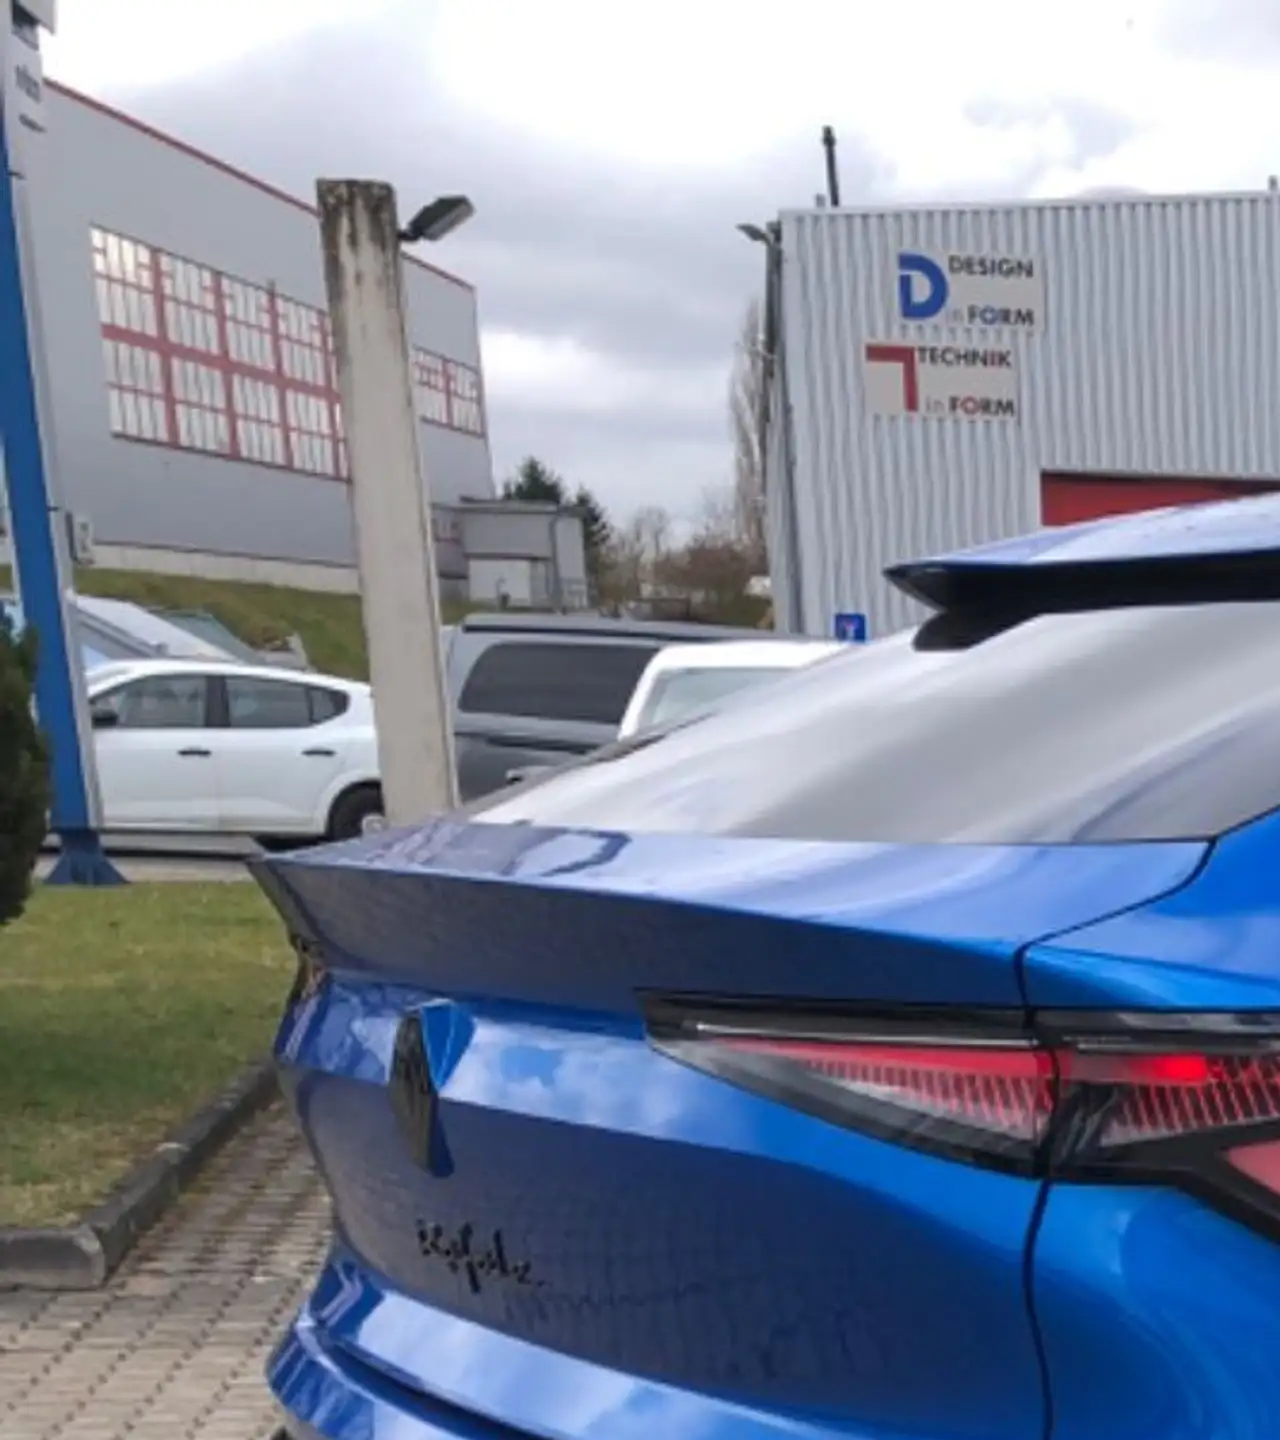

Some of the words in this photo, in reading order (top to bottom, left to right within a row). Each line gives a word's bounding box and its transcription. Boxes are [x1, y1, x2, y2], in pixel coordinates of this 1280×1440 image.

[948, 254, 1034, 278] DESIGN
[967, 305, 1035, 327] FORM
[918, 346, 1012, 367] TECHNIK
[949, 395, 1015, 417] FORM
